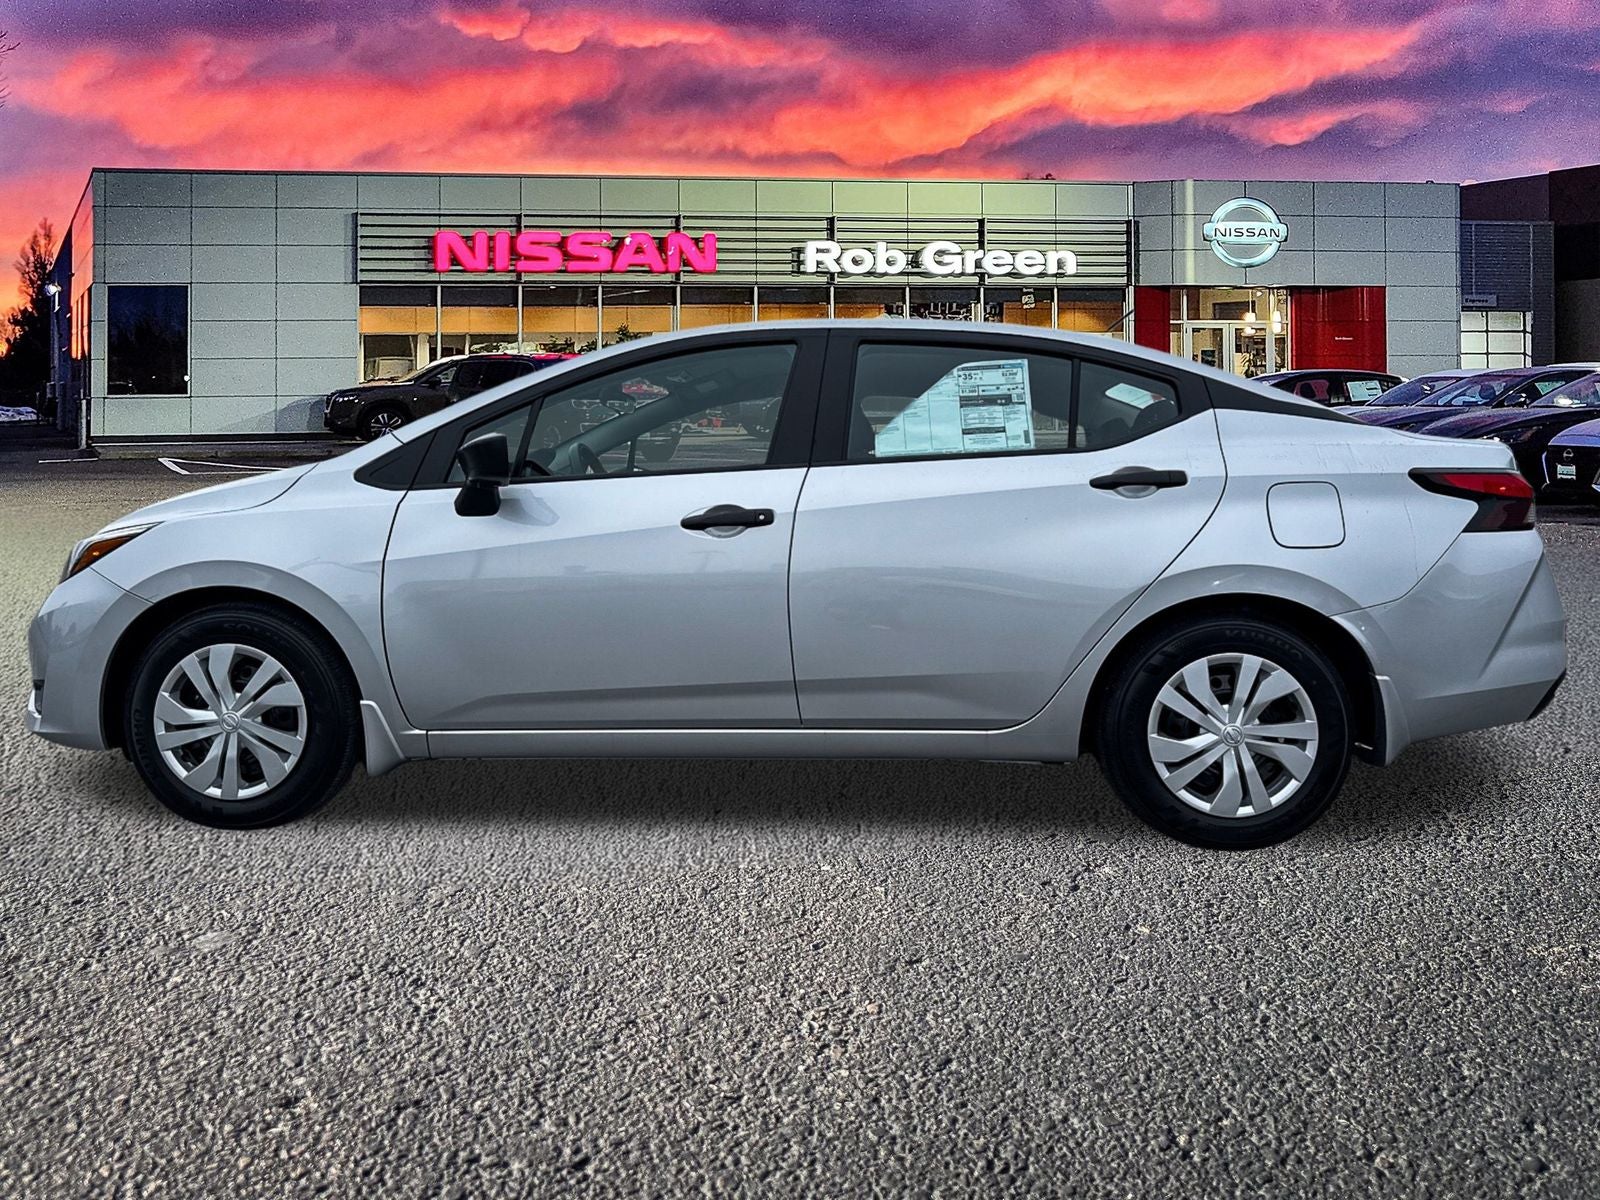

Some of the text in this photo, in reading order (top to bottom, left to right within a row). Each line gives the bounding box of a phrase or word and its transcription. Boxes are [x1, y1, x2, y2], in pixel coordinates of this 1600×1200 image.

[1214, 227, 1280, 238] NISSAN
[434, 230, 718, 273] NISSAN
[804, 240, 1078, 275] Rob Green
